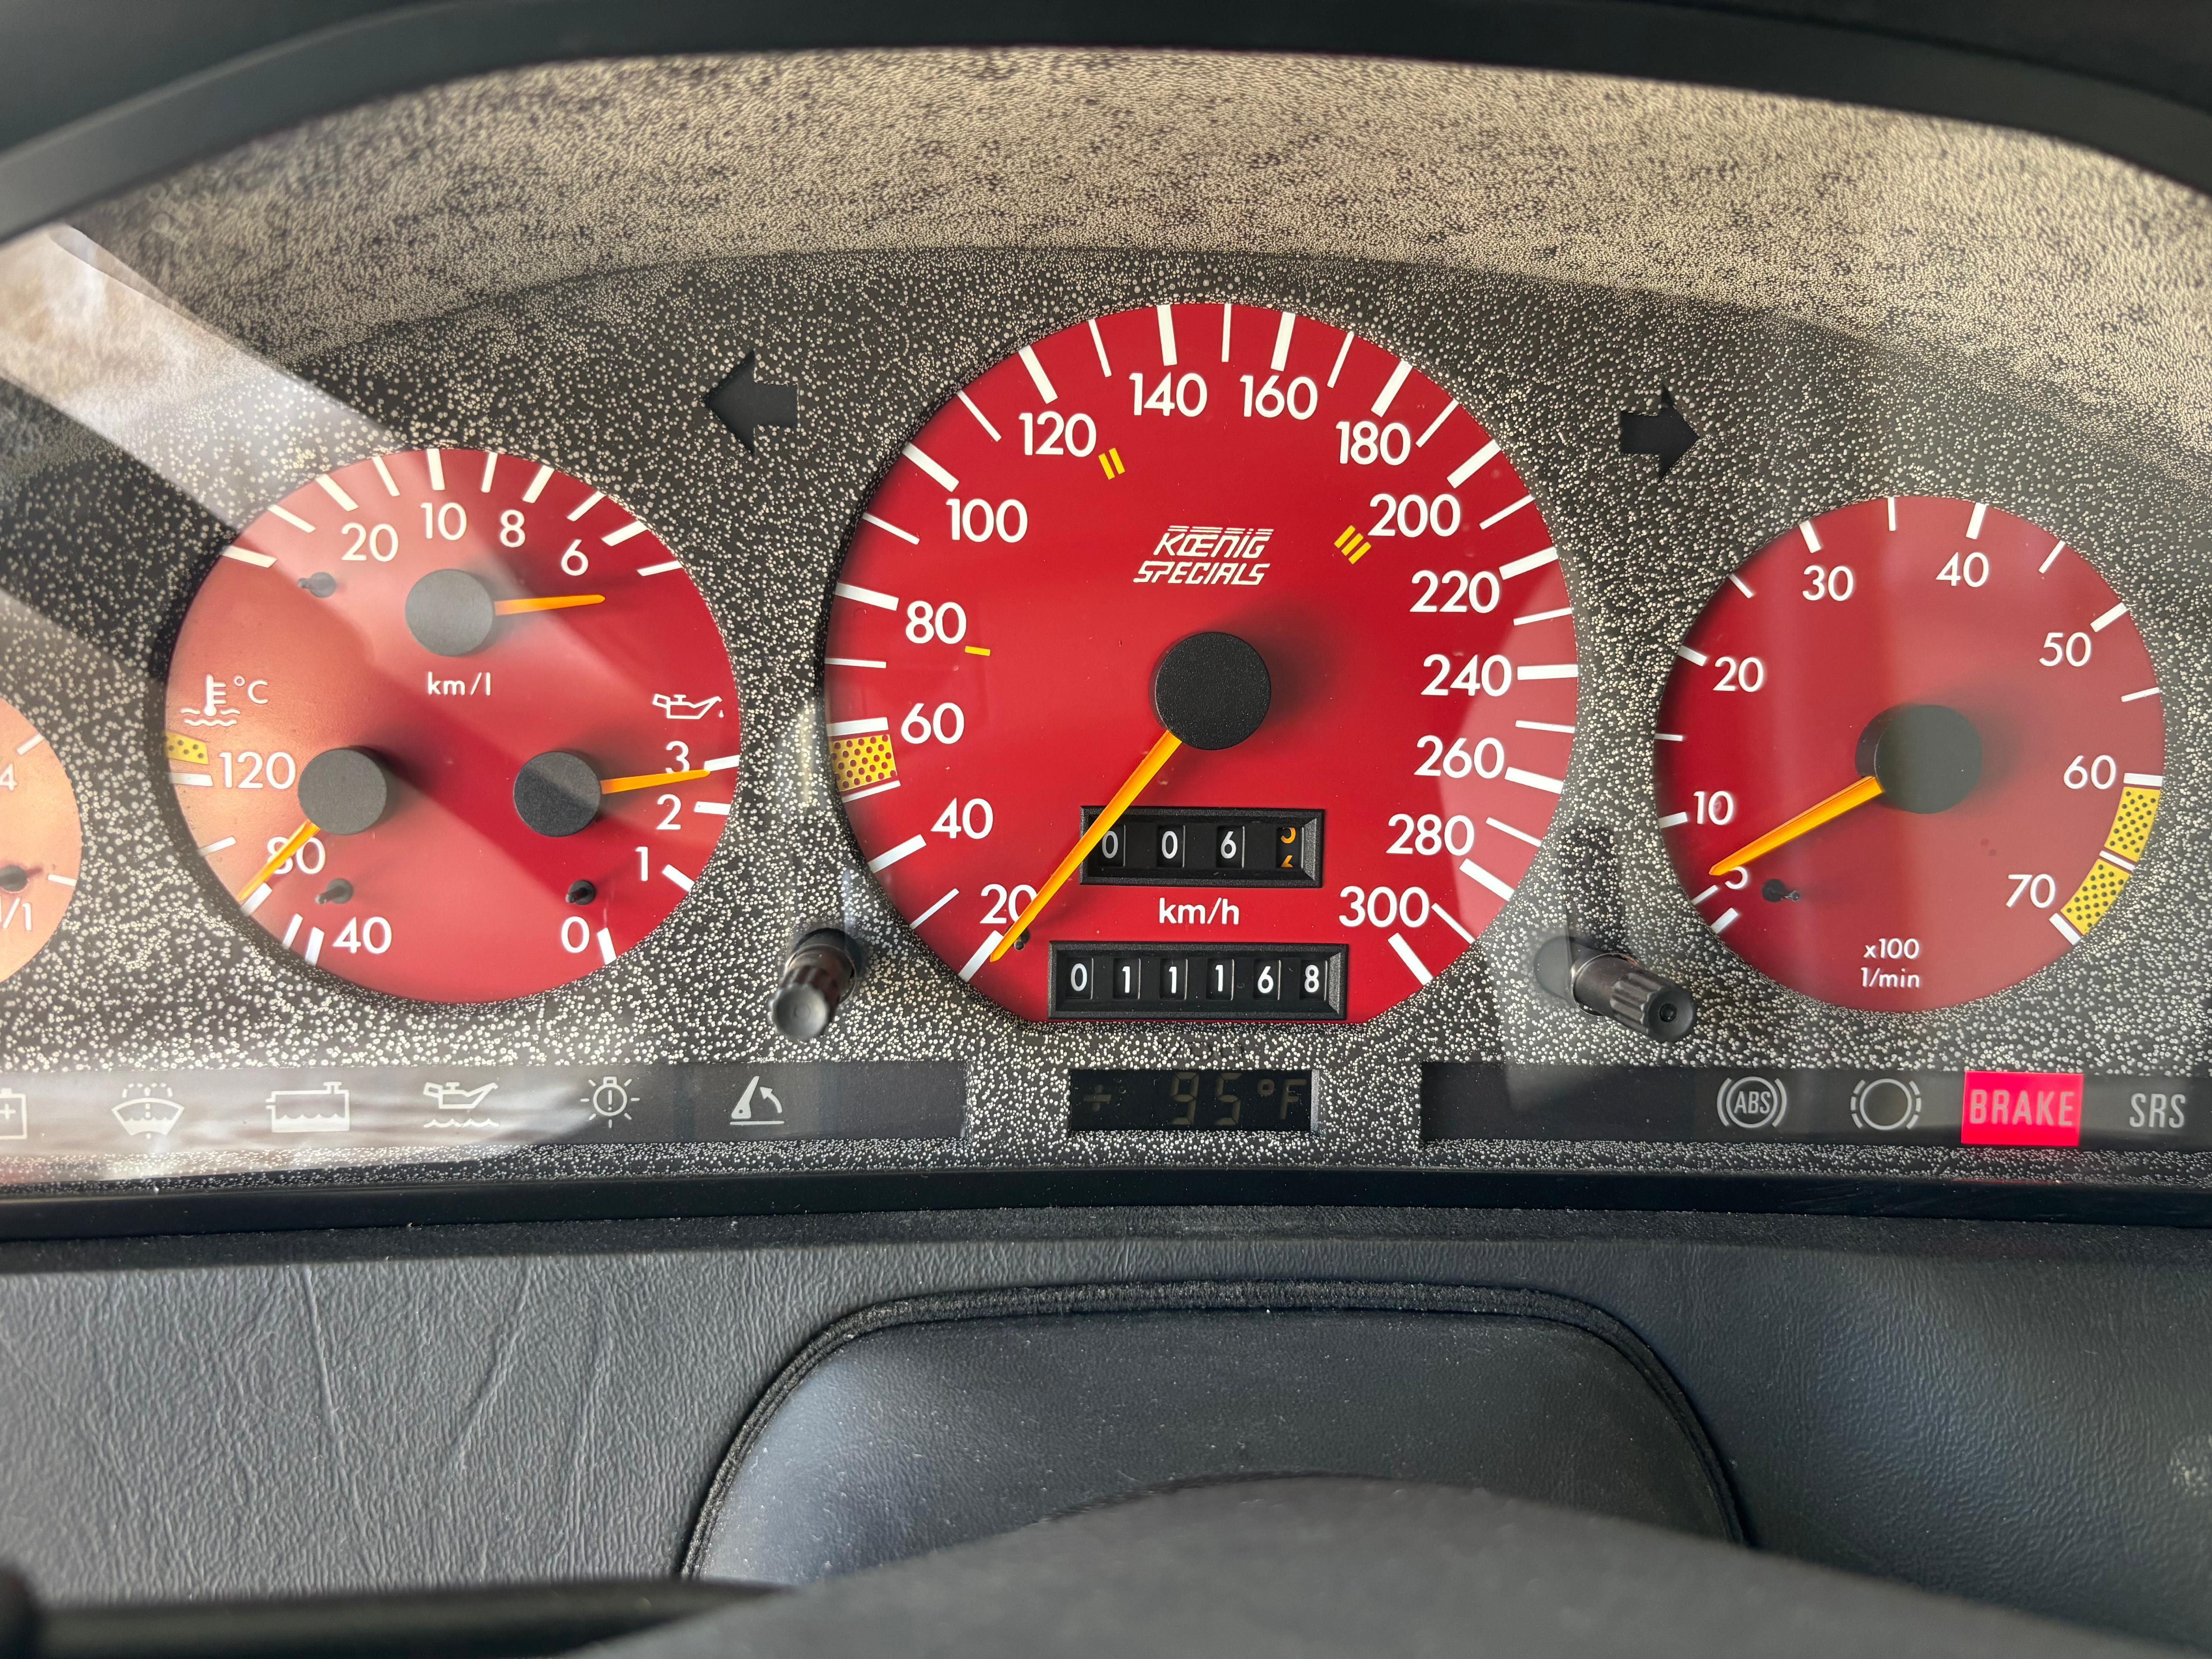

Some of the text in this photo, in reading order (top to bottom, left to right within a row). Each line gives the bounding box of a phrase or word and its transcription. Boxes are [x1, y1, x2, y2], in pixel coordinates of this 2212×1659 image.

[1129, 373, 1208, 417] 140
[1240, 375, 1318, 420] 160
[1019, 411, 1096, 457] 120
[1336, 421, 1411, 465] 180
[420, 502, 467, 541] 10
[499, 509, 526, 548] 8
[946, 498, 1028, 543] 100
[1368, 493, 1460, 538] 200
[341, 524, 399, 562] 20
[560, 539, 588, 576] 6
[1133, 560, 1271, 585] SPECIALS
[1802, 565, 1853, 601] 30
[1936, 552, 1989, 587] 40
[1409, 569, 1500, 613] 220
[905, 601, 966, 644] 80
[2039, 632, 2091, 667] 50
[233, 676, 269, 705] °C
[427, 671, 492, 696] km/l
[1421, 654, 1512, 697] 240
[1712, 656, 1764, 692] 20
[901, 702, 964, 744] 60
[219, 751, 296, 789] 120
[665, 741, 690, 774] 3
[1414, 735, 1505, 779] 260
[2063, 755, 2117, 789] 60
[657, 795, 680, 830] 2
[931, 798, 993, 839] 40
[1693, 791, 1733, 826] 10
[1386, 814, 1475, 856] 280
[267, 836, 326, 874] 80
[636, 847, 649, 881] 1
[980, 884, 1038, 924] 20
[1339, 886, 1430, 928] 300
[2006, 873, 2056, 908] 70
[0, 895, 32, 931] /1
[1159, 897, 1239, 925] km/h
[333, 916, 392, 953] 40
[560, 916, 591, 953] 0
[1863, 938, 1920, 959] x100
[1071, 963, 1319, 993] 011168
[1860, 968, 1920, 988] 1/min
[1733, 1091, 1771, 1114] ABS
[1970, 1090, 2074, 1126] BRAKE
[2129, 1093, 2186, 1128] SRS
